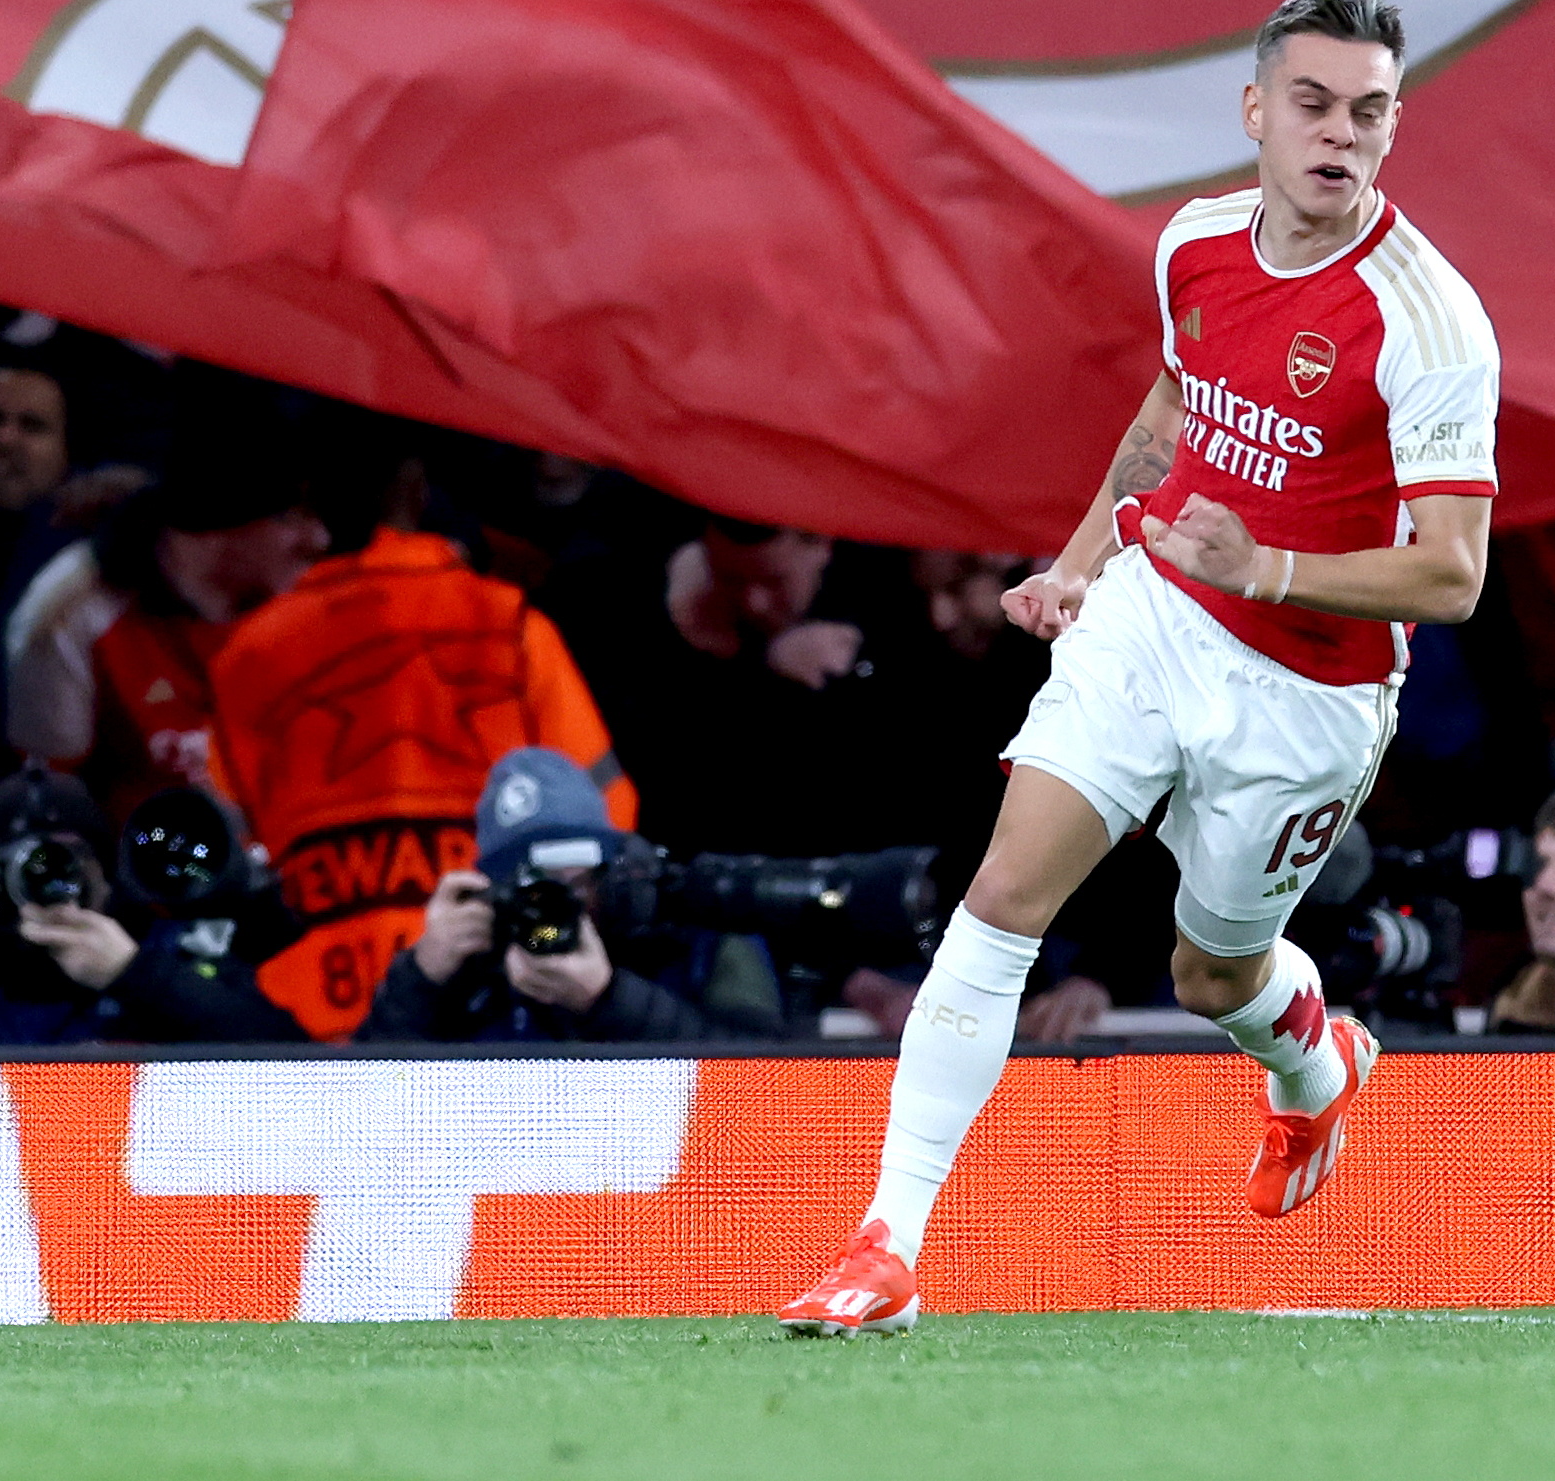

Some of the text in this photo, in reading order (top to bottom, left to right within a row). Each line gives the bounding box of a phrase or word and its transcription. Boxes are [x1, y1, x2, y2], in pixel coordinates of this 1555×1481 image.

[1180, 370, 1324, 458] mirates
[1204, 427, 1288, 492] BETTER
[282, 827, 481, 913] EWAR
[1264, 799, 1345, 874] 19
